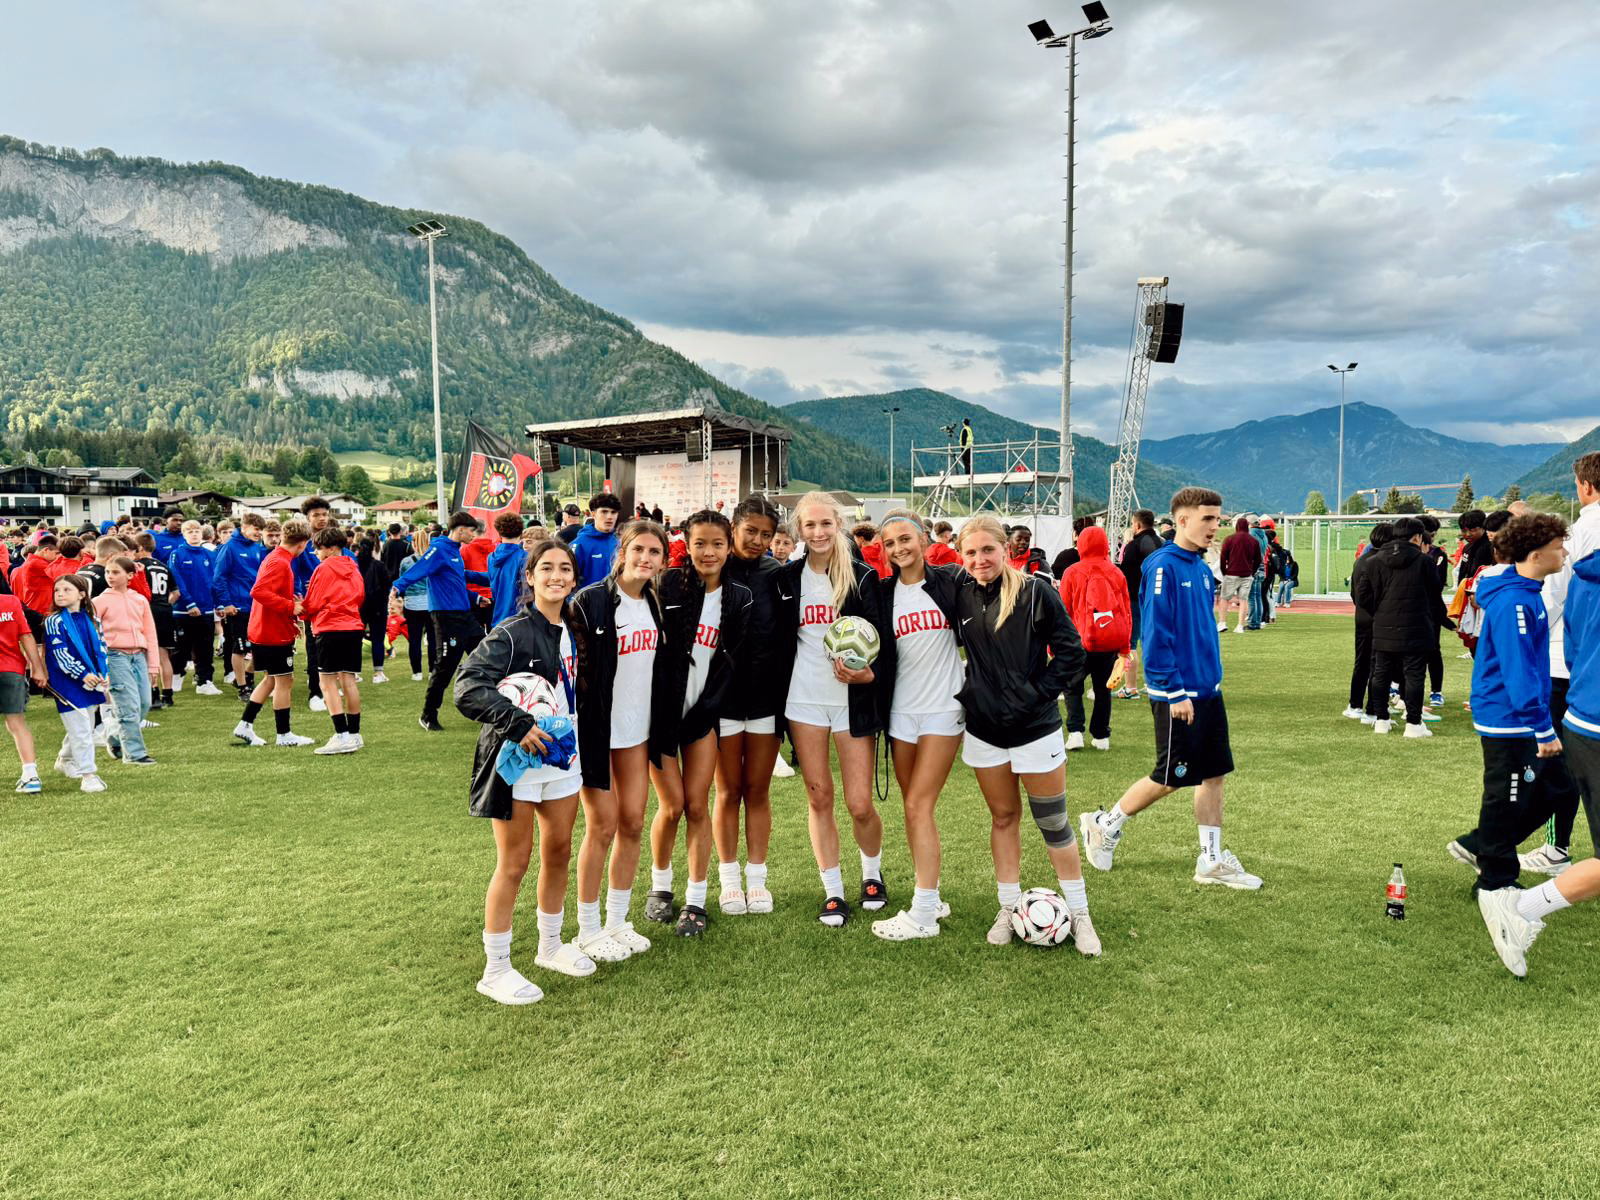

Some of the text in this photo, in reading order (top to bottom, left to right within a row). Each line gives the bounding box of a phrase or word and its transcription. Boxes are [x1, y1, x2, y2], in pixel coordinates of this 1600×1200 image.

[151, 571, 168, 595] 16
[800, 604, 840, 627] ORI
[617, 629, 658, 655] LORI
